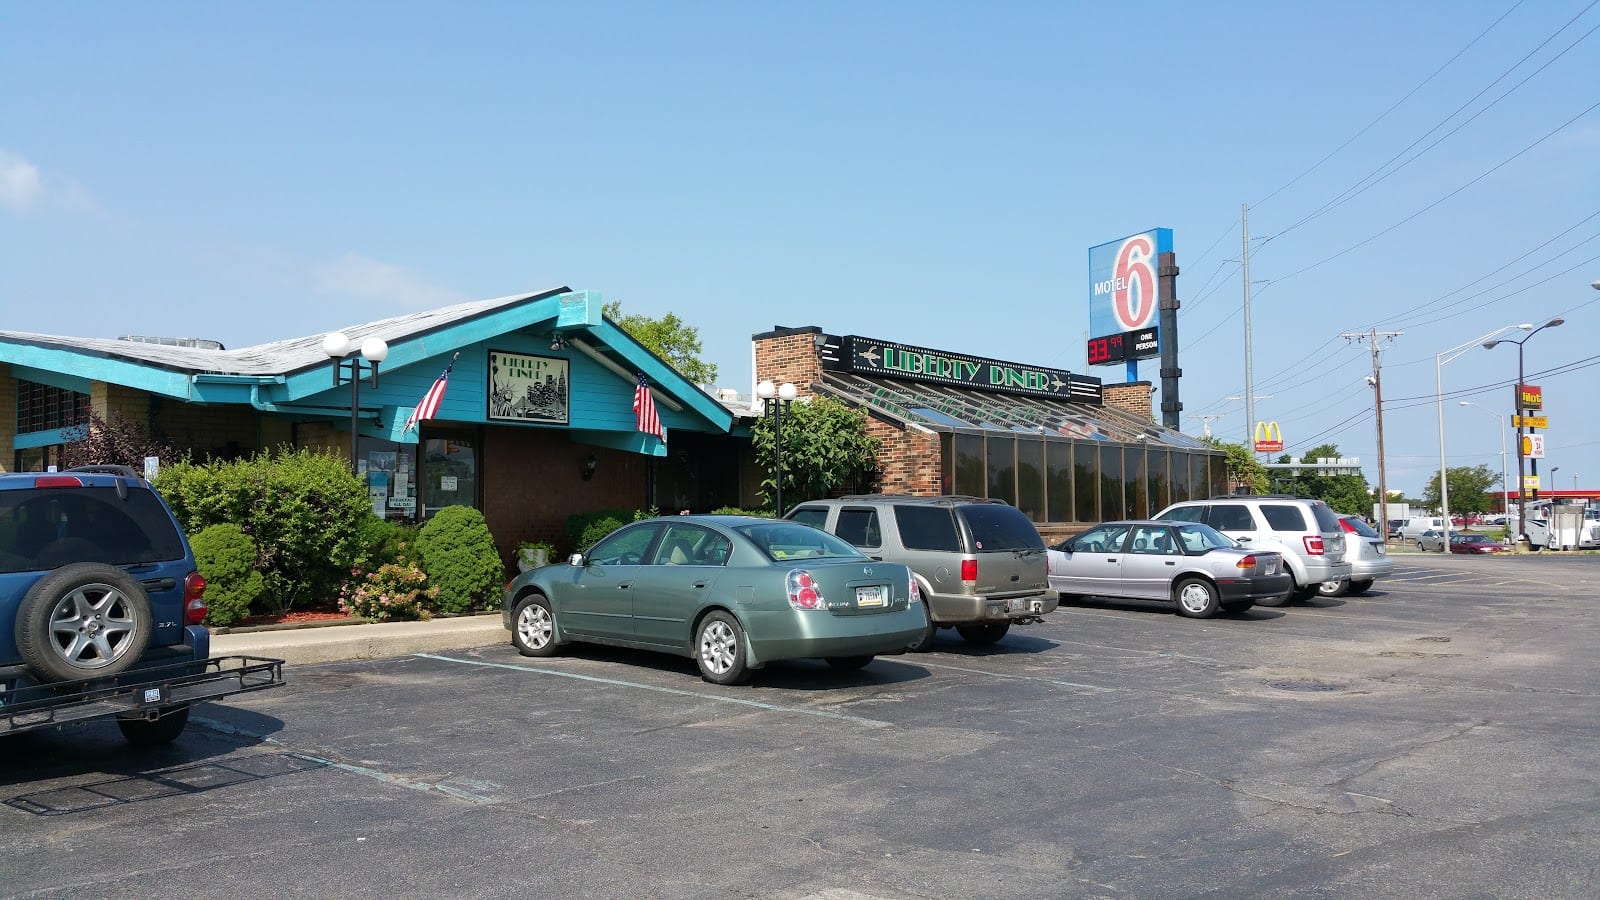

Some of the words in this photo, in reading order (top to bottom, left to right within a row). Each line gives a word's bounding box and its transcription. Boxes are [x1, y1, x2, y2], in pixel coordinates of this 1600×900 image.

[1094, 277, 1128, 296] MOTEL
[1113, 236, 1155, 330] 6
[1140, 332, 1153, 341] ONE
[1135, 339, 1158, 351] PERSON
[883, 347, 981, 383] LIBERTY
[989, 364, 1050, 393] DINER
[1522, 391, 1542, 403] ilot
